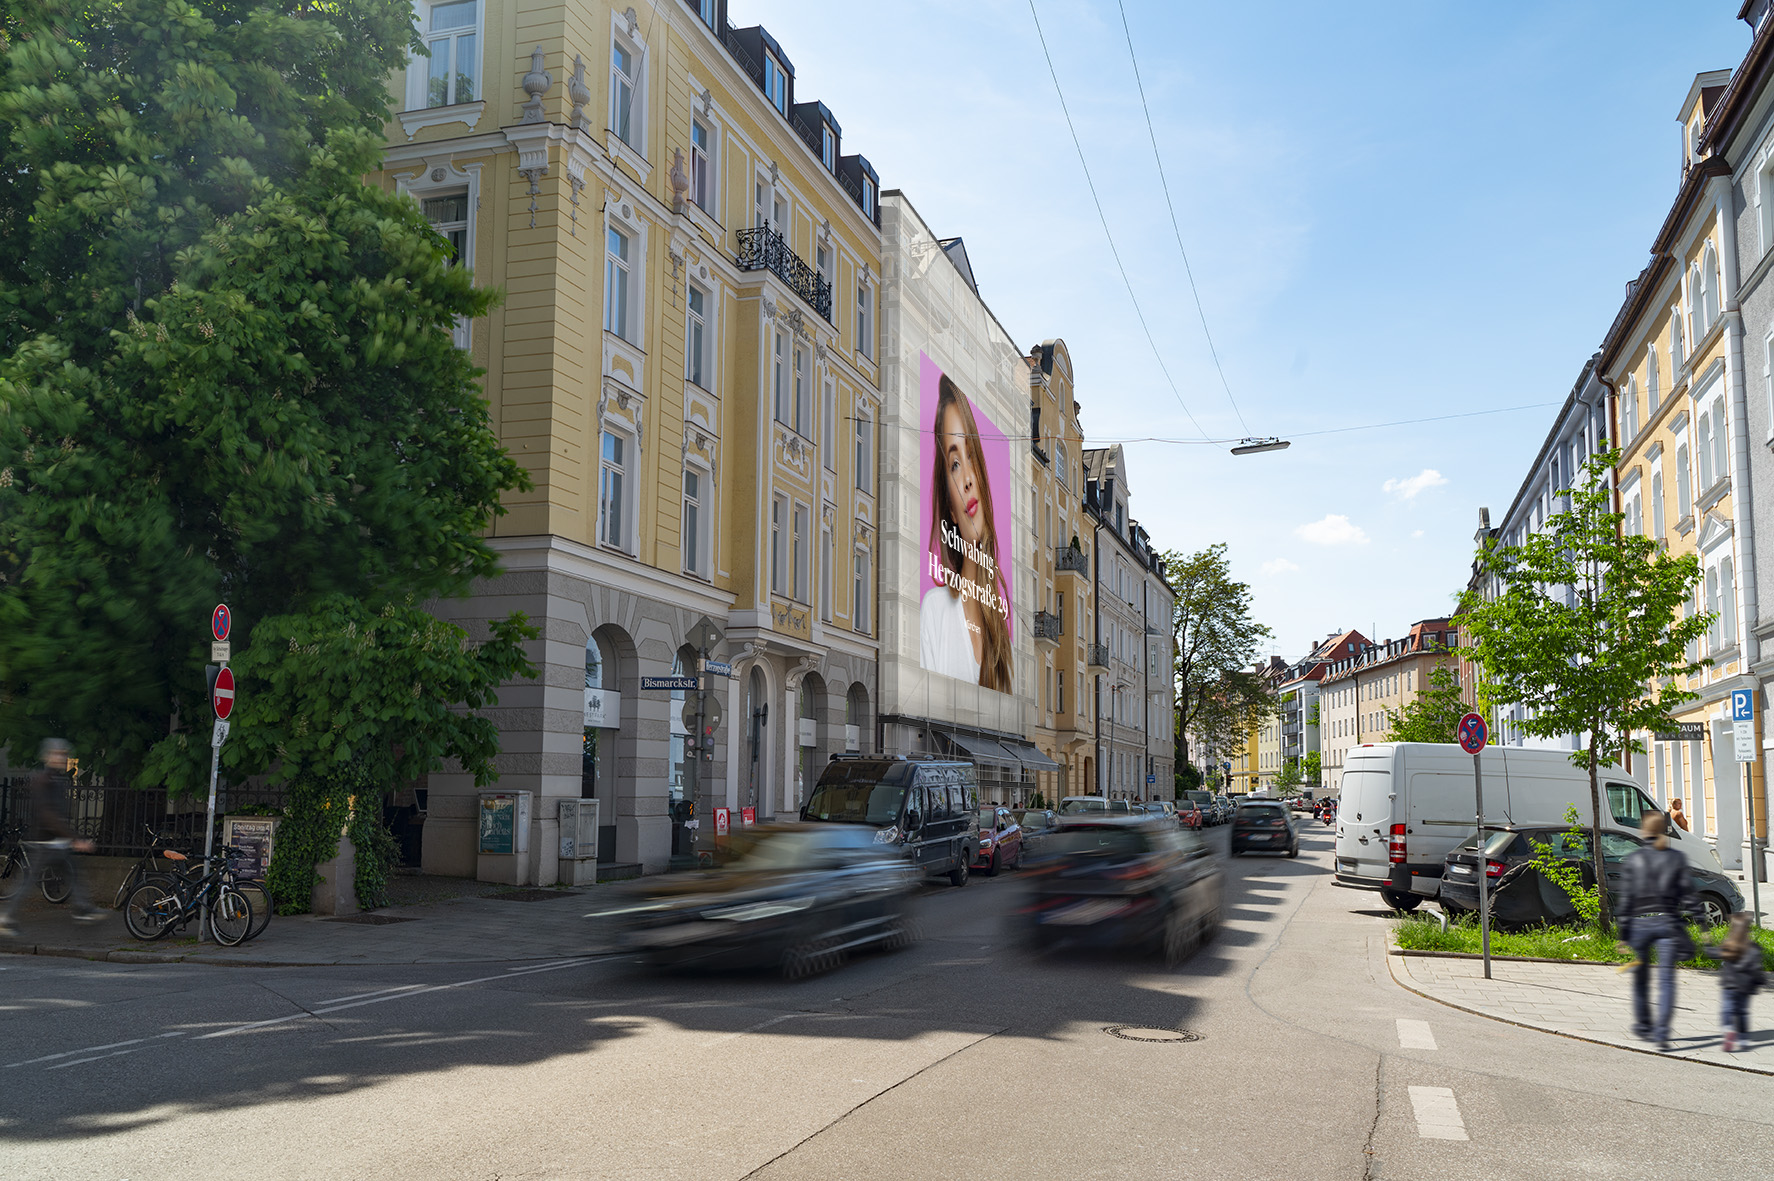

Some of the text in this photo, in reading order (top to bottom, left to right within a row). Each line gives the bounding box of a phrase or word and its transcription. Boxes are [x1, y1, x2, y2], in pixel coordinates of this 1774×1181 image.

[941, 519, 994, 580] Schwabing
[928, 551, 1008, 620] Herzogstraße 29
[644, 679, 696, 688] Bismarckstr.
[1735, 694, 1747, 718] P
